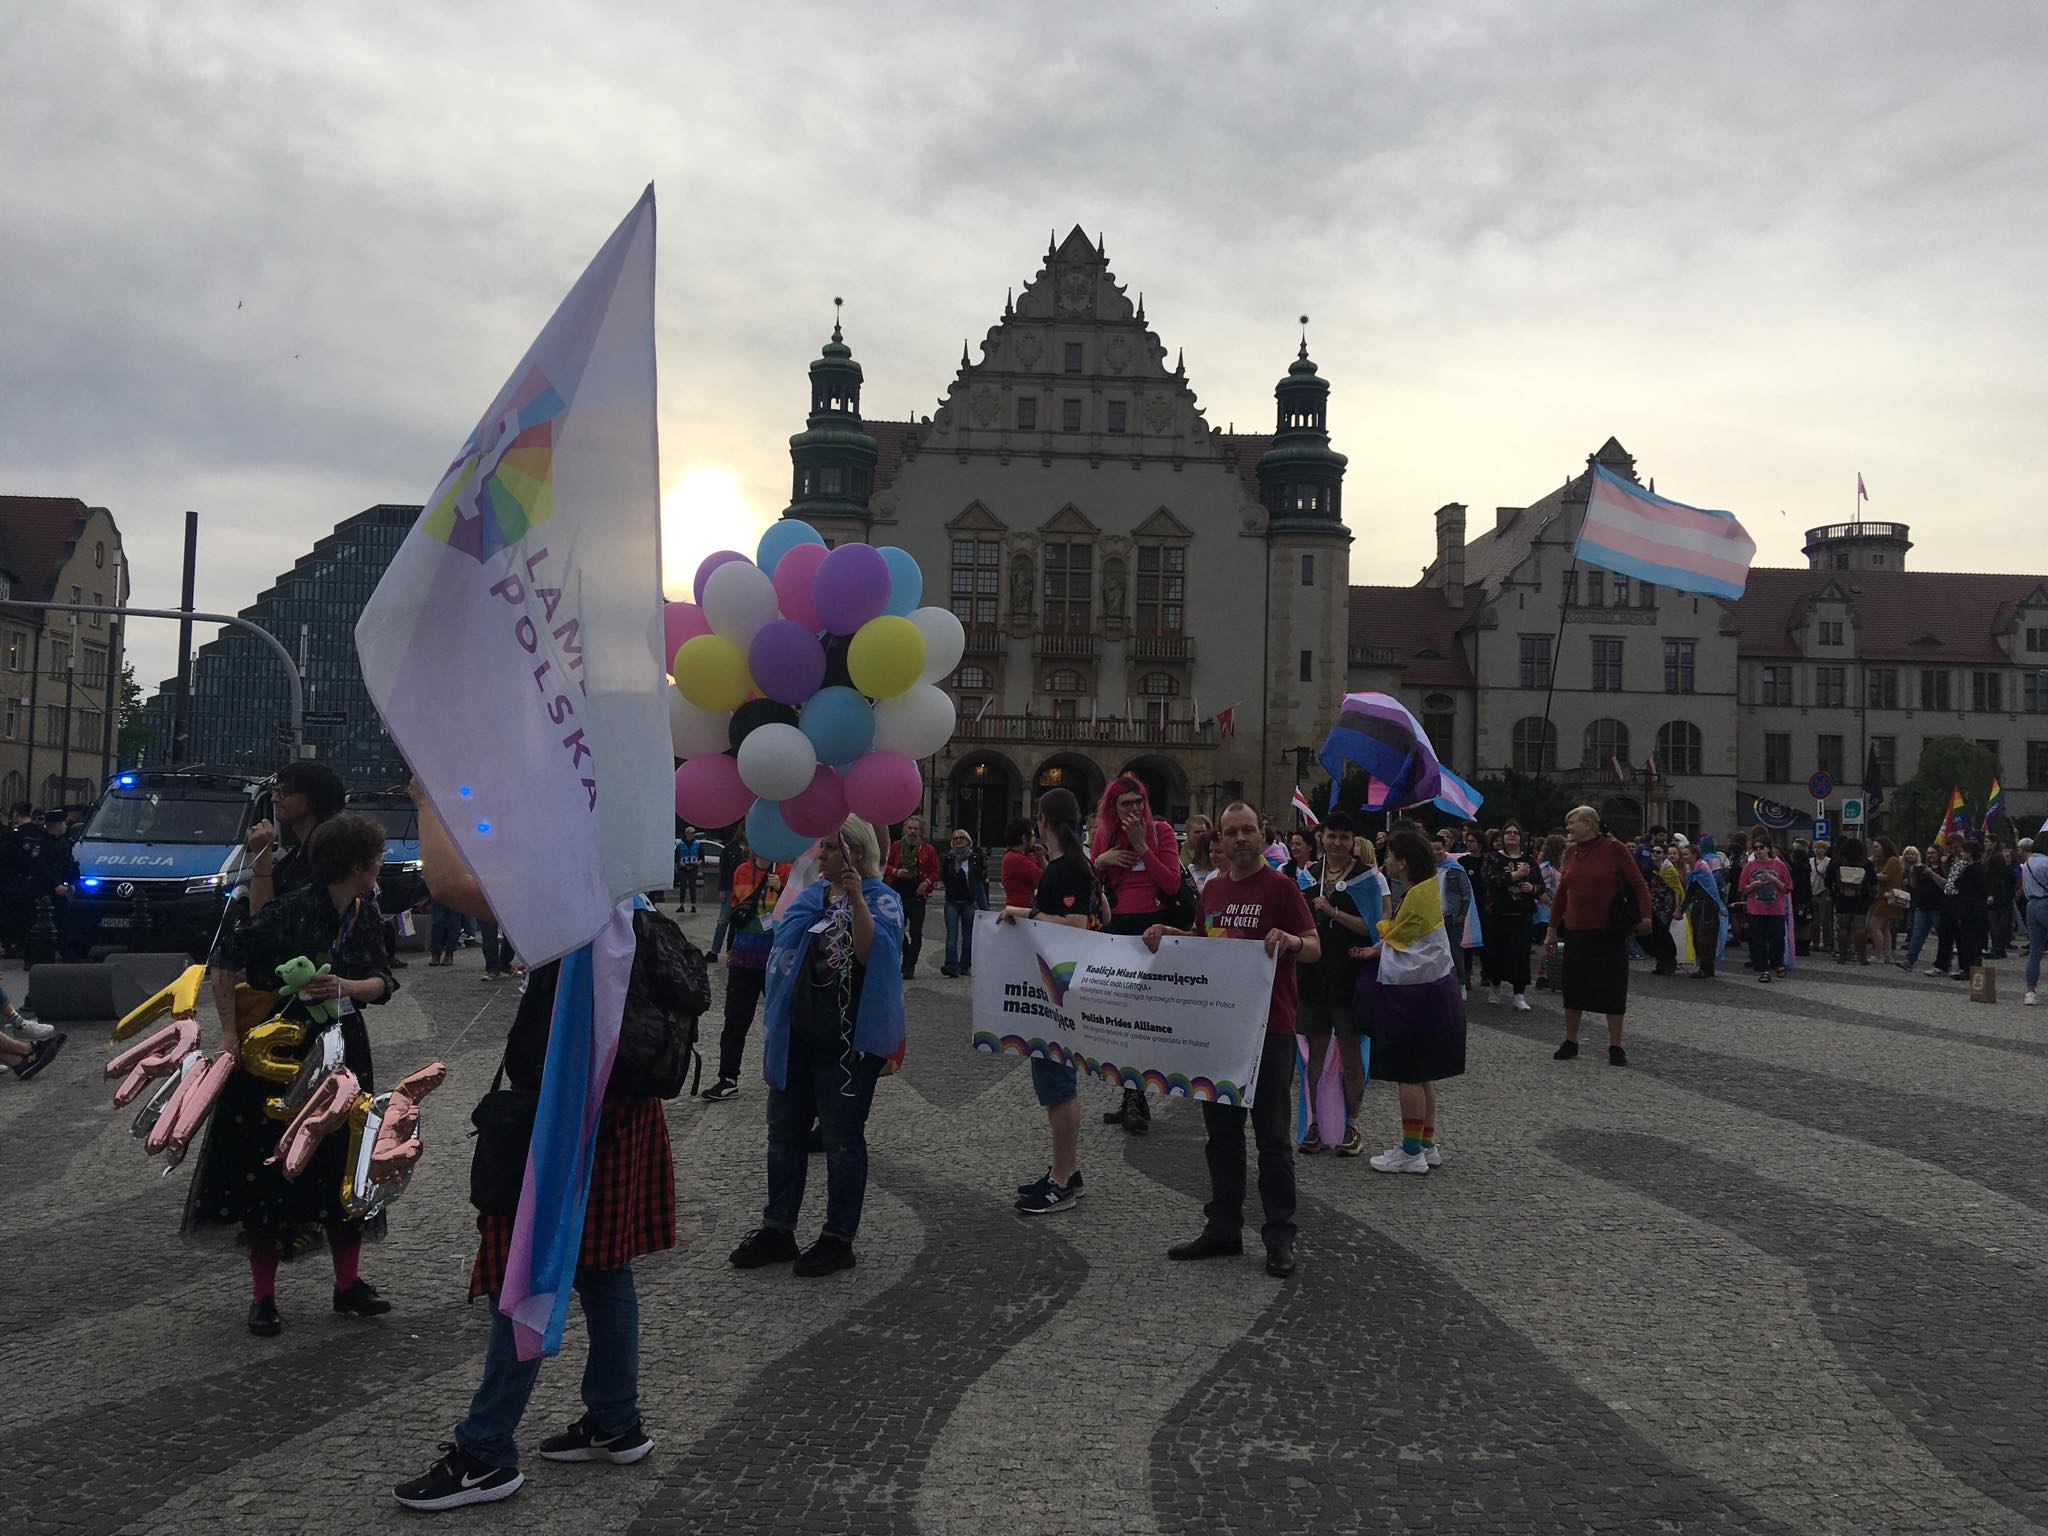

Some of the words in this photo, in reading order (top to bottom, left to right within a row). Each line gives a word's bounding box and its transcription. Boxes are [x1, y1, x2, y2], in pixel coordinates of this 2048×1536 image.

[489, 573, 597, 813] POLSKA
[1816, 822, 1827, 838] P
[94, 855, 175, 867] POLICJA
[1226, 903, 1240, 915] OH
[1240, 904, 1263, 916] DEER
[1220, 915, 1232, 927] I'M
[1233, 916, 1259, 928] QUEER
[1086, 965, 1116, 977] Koalicja
[1116, 969, 1137, 978] Miast
[1137, 971, 1208, 985] Maszerujących
[1215, 1000, 1236, 1009] Polsce
[1081, 1012, 1105, 1025] Polish
[1106, 1017, 1132, 1029] Prides
[1134, 1020, 1173, 1033] Alliance
[1188, 1039, 1210, 1049] Poland
